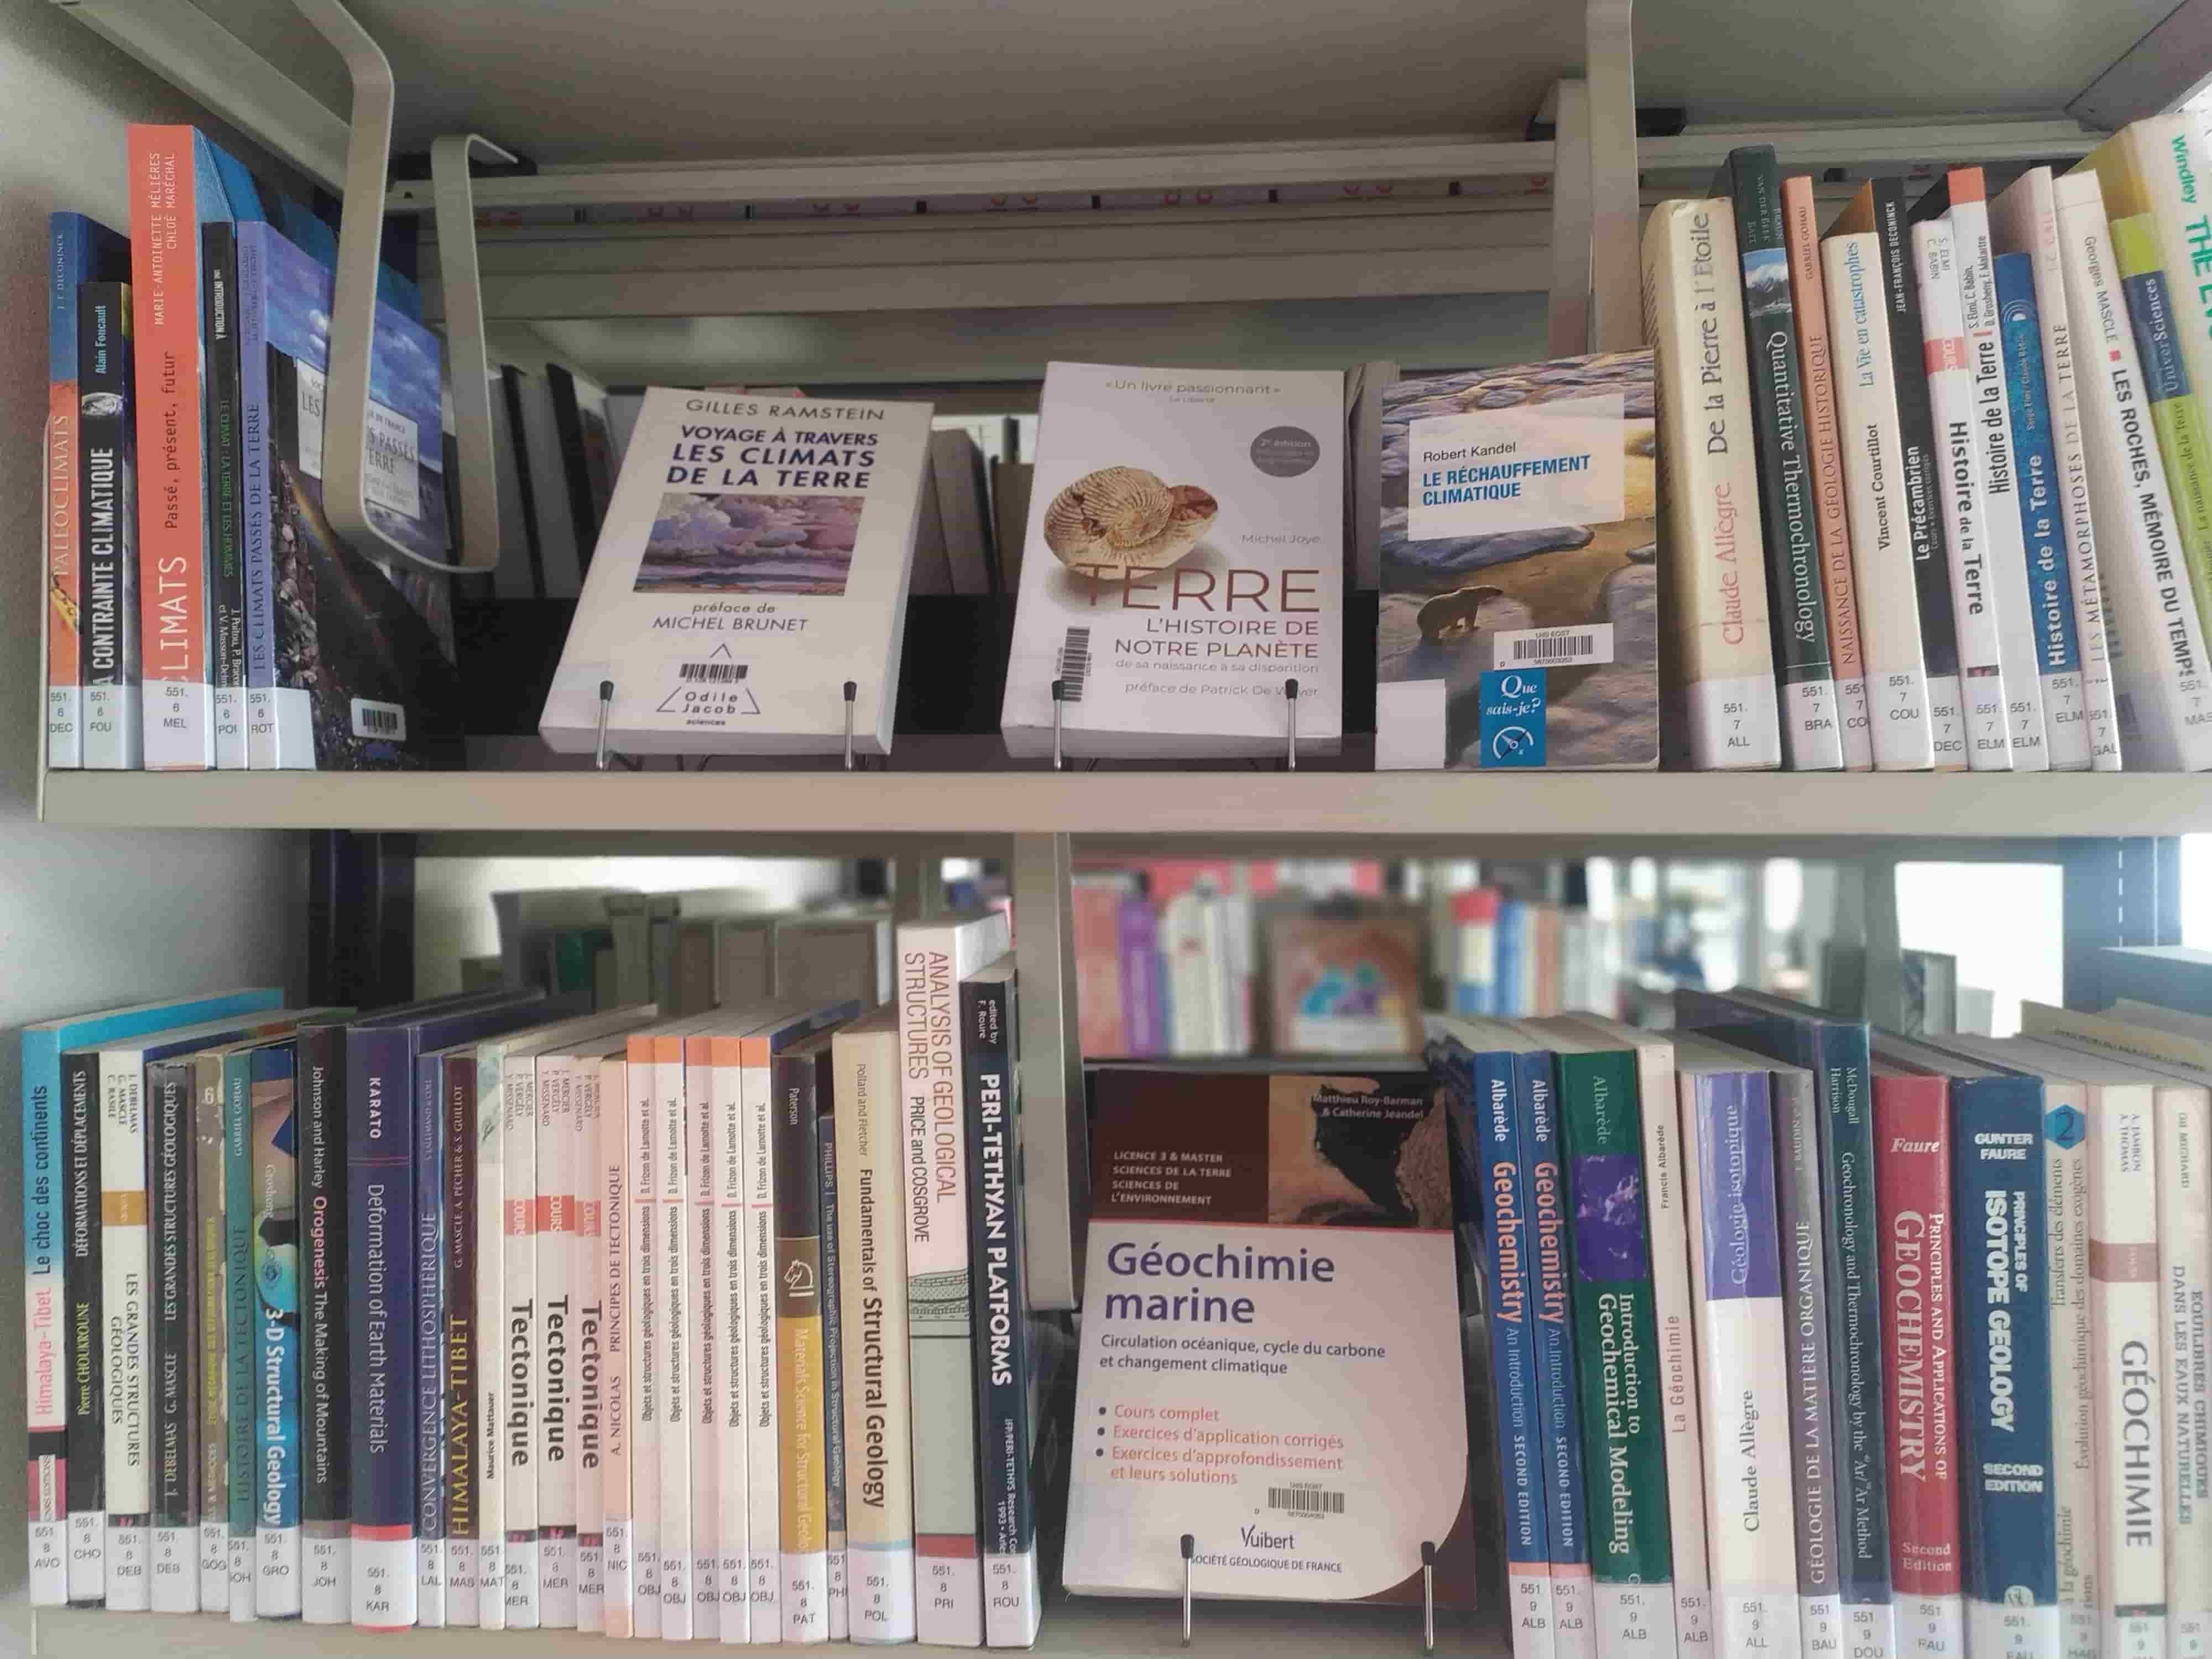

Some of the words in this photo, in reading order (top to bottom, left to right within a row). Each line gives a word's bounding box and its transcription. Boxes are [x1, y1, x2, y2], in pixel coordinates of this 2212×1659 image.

[2184, 215, 2207, 277] THE
[150, 213, 165, 325] MARIE-ANTOINETTE
[94, 305, 107, 348] Foucault
[2098, 290, 2118, 342] MASCLE
[95, 350, 107, 374] Alain
[1701, 318, 1722, 386] Pierre
[1976, 341, 1997, 385] Terre
[163, 352, 176, 396] futur
[1766, 331, 1795, 450] Quantitative
[686, 399, 758, 416] GILLES
[769, 404, 885, 420] RAMSTEIN
[1703, 393, 1724, 411] la
[1978, 387, 2000, 404] la
[681, 425, 766, 442] VOYAGE
[771, 426, 786, 442] À
[795, 432, 878, 446] TRAVERS
[1707, 419, 1728, 455] De
[1981, 408, 2002, 428] de
[673, 444, 724, 463] LES
[740, 447, 875, 466] CLIMATS
[1423, 450, 1467, 462] Robert
[1471, 442, 1516, 457] Kandel
[1423, 470, 1441, 487] LE
[1447, 455, 1590, 484] RÉCHAUFFEMENT
[1866, 424, 1884, 492] Courtillot
[1986, 432, 2010, 495] Histoire
[666, 467, 707, 484] DE
[722, 469, 758, 486] LA
[777, 471, 870, 488] TERRE
[1423, 483, 1521, 506] CLIMATIQUE
[1906, 445, 1925, 539] Précambrien
[2030, 455, 2047, 512] Terre
[2110, 368, 2131, 402] LES
[2140, 493, 2173, 581] MÉMOIRE
[90, 446, 114, 555] CLIMATIQUE
[1949, 421, 1975, 512] Histoire
[1964, 553, 1983, 615] Terre
[1877, 496, 1890, 551] Vincent
[2034, 518, 2051, 538] la
[1782, 455, 1815, 643] Thermochronology
[1914, 544, 1931, 561] Le
[2037, 545, 2053, 571] de
[692, 603, 750, 614] préface
[757, 603, 776, 613] de
[1075, 563, 1320, 613] TERRE
[1719, 572, 1744, 645] Claude
[92, 558, 114, 670] CONTRAINTE
[158, 556, 186, 681] LIMATS
[653, 617, 724, 630] MICHEL
[732, 617, 809, 631] BRUNET
[1146, 618, 1276, 635] L'HISTOIRE
[1285, 620, 1318, 635] DE
[2043, 580, 2068, 666] Histoire
[1115, 639, 1197, 656] NOTRE
[1207, 638, 1318, 658] PLANÈTE
[1501, 675, 1537, 697] Que
[90, 722, 112, 733] FOU
[164, 718, 186, 729] MEL
[682, 704, 735, 714] Jacob
[1487, 698, 1541, 717] sais-je?
[1890, 709, 1919, 720] COU
[1727, 737, 1750, 748] ALL
[905, 952, 929, 1080] STRUCTURES
[929, 952, 951, 1046] ANALYSIS
[932, 1051, 952, 1078] OF
[30, 1084, 50, 1170] continents
[367, 1078, 381, 1139] KARATO
[910, 1096, 925, 1136] PRICE
[1491, 1079, 1510, 1142] Albarède
[1593, 1076, 1610, 1145] Albarède
[911, 1140, 926, 1166] and
[933, 1083, 957, 1203] GEOLOGICAL
[980, 1074, 1006, 1239] PERI-TETHYAN
[1114, 1151, 1156, 1161] LICENCE
[1181, 1154, 1223, 1163] MASTER
[1891, 1138, 1939, 1153] Faure
[1981, 1149, 2026, 1160] FAURE
[32, 1172, 50, 1206] des
[1113, 1166, 1162, 1176] SCIENCES
[859, 1168, 877, 1272] Fundamentals
[912, 1164, 929, 1243] COSGROVE
[1112, 1193, 1212, 1206] L'ENVIRONNEMENT
[32, 1209, 50, 1251] choc
[310, 1196, 327, 1289] Orogenesis
[367, 1184, 388, 1296] Deformation
[1493, 1162, 1527, 1323] Geochemistry
[1984, 1191, 2010, 1304] ISOTOPE
[33, 1256, 50, 1275] Le
[1107, 1242, 1335, 1282] Géochimie
[265, 1308, 284, 1340] 3-D
[369, 1300, 387, 1318] of
[988, 1248, 1011, 1386] PLATFORMS
[1105, 1288, 1255, 1324] marine
[369, 1323, 389, 1370] Earth
[863, 1297, 884, 1410] Structural
[1101, 1335, 1176, 1349] Circulation
[1181, 1337, 1259, 1354] océanique,
[1263, 1340, 1298, 1355] cycle
[1326, 1343, 1385, 1358] carbone
[1118, 1357, 1207, 1372] changement
[1212, 1359, 1287, 1375] climatique
[1599, 1293, 1627, 1438] Geochemical
[1618, 1293, 1642, 1410] Introduction
[1894, 1211, 1926, 1483] GEOCHEMISTRY
[507, 1299, 534, 1467] Tectonique
[1988, 1311, 2015, 1432] GEOLOGY
[265, 1346, 285, 1443] Structural
[370, 1375, 388, 1454] Materials
[1115, 1405, 1155, 1420] Cours
[1160, 1407, 1219, 1422] complet
[316, 1402, 327, 1485] Mountains
[1114, 1426, 1180, 1441] Exercices
[1284, 1433, 1343, 1448] corrigés
[1627, 1415, 1640, 1434] to
[2120, 1340, 2156, 1547] GÉOCHIMIE
[863, 1416, 888, 1509] Geology
[1113, 1447, 1178, 1461] Exercices
[1983, 1463, 2043, 1477] SECOND
[264, 1446, 286, 1527] Geology
[1129, 1467, 1165, 1481] leurs
[1170, 1469, 1238, 1485] solutions
[1985, 1480, 2043, 1493] EDITION
[1608, 1446, 1632, 1554] Modeling
[1744, 1466, 1760, 1531] Claude
[1241, 1525, 1294, 1549] Vuibert
[1229, 1556, 1289, 1571] GÉOLOGIQUE
[1306, 1561, 1342, 1572] FRANCE
[793, 1613, 816, 1624] PAT
[1622, 1629, 1647, 1640] ALB
